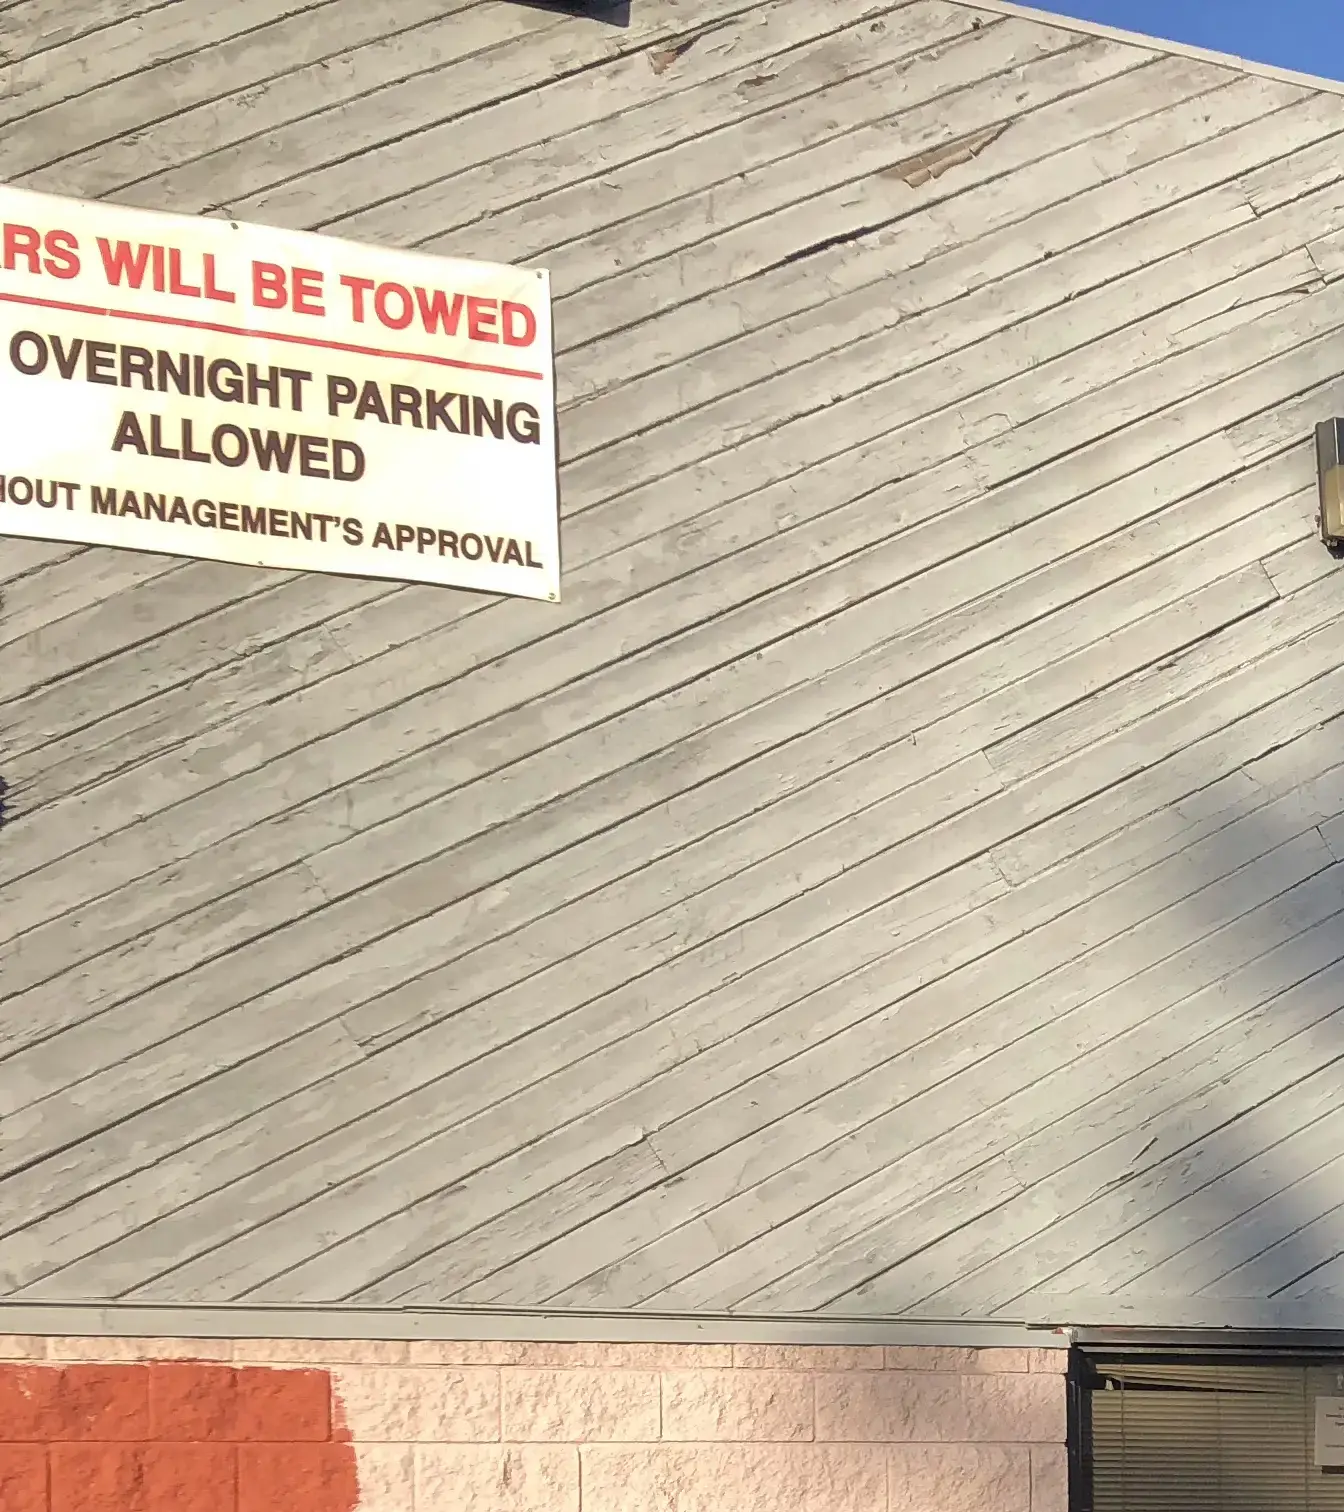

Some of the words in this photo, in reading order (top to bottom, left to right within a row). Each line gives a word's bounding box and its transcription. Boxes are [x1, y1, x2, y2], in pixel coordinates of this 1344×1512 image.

[0, 222, 81, 279] RS
[95, 236, 235, 303] WILL
[252, 260, 325, 317] BE
[340, 274, 536, 347] TOWED
[9, 330, 312, 412] OVERNIGHT
[327, 375, 541, 445] PARKING
[111, 411, 365, 482] ALLOWED
[90, 485, 363, 546] MANAGEMENT'S
[372, 523, 543, 569] APPROVAL
